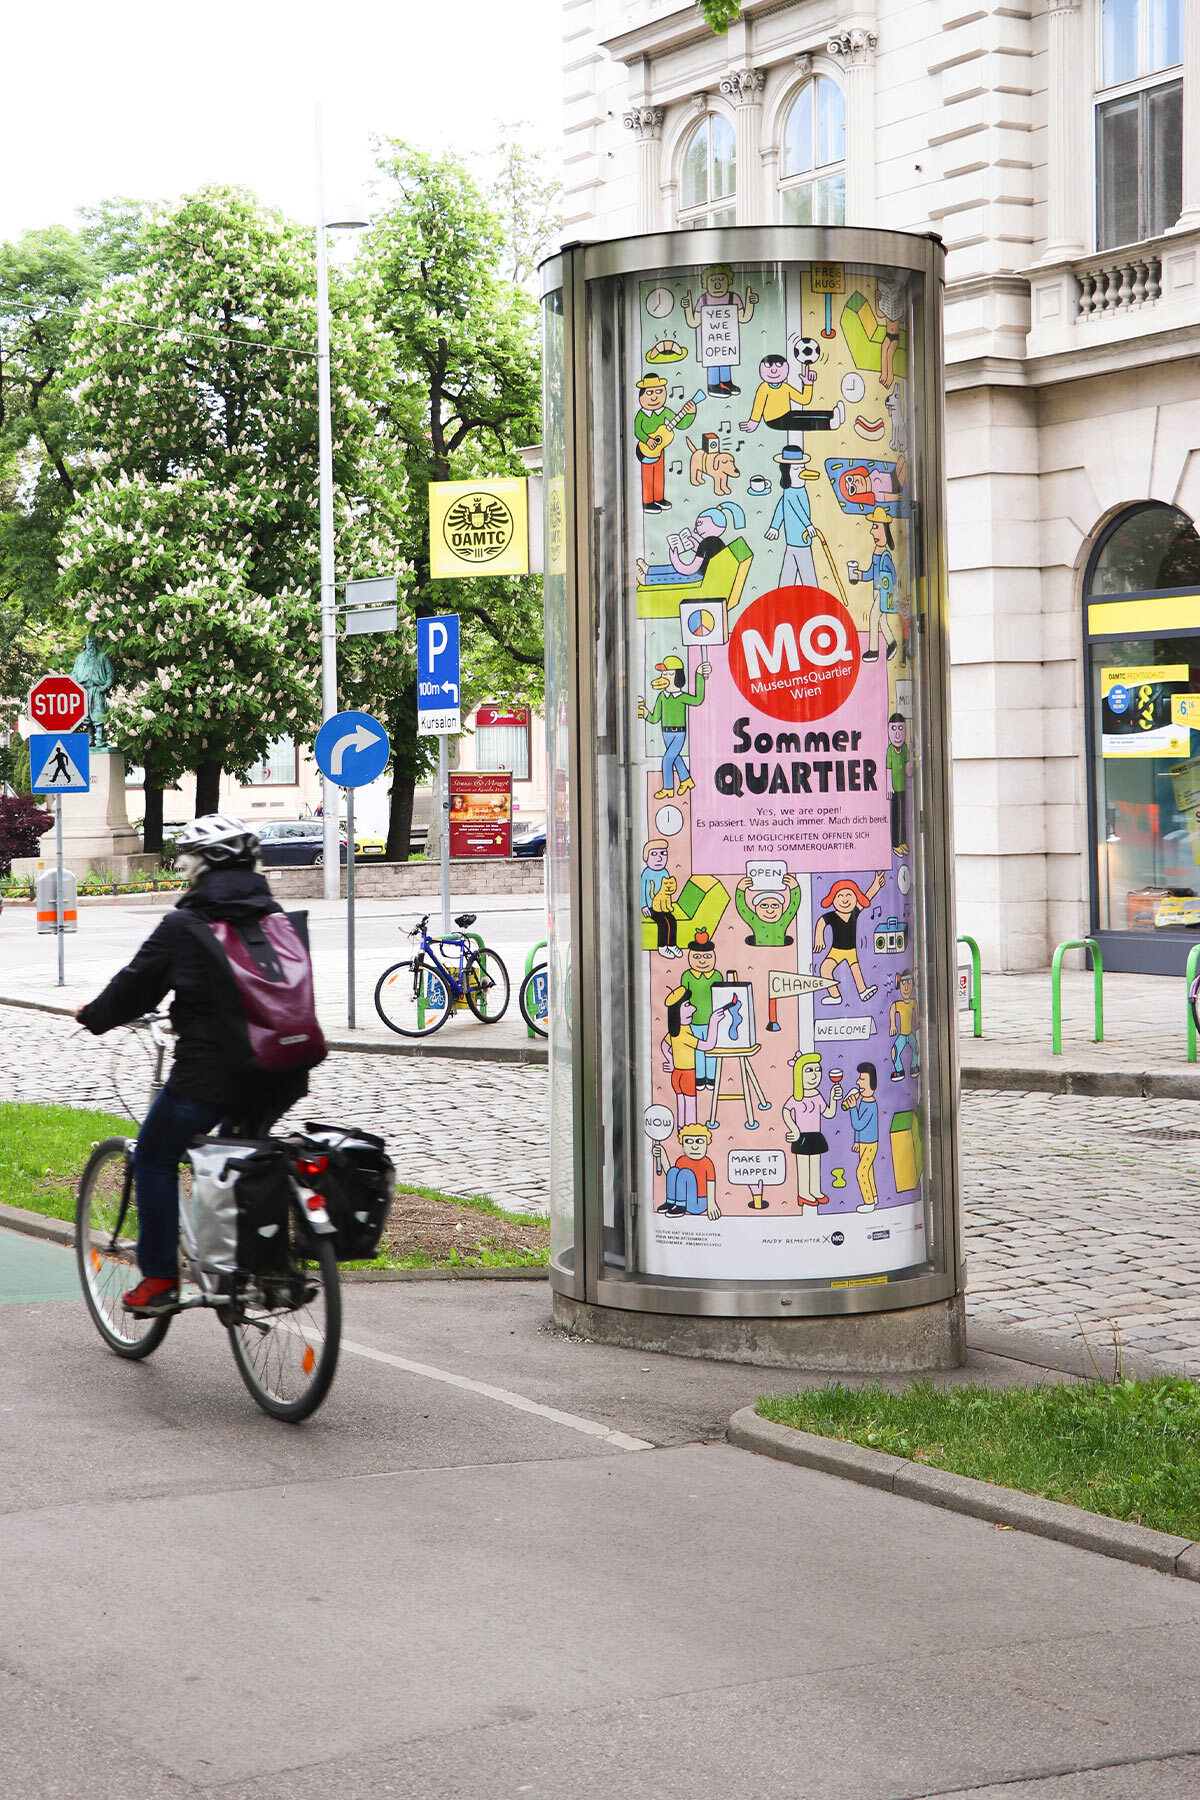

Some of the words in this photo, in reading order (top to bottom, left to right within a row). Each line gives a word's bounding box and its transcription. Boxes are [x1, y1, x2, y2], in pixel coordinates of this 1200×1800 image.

[815, 266, 841, 278] FREE
[814, 279, 841, 289] HUGS
[706, 309, 731, 319] YES
[710, 321, 728, 330] WE
[708, 332, 731, 342] ARE
[705, 346, 737, 357] OPEN
[428, 622, 448, 673] P
[741, 614, 853, 680] MQ
[750, 666, 852, 694] MuseumsQuartier
[419, 681, 440, 696] 100m
[790, 687, 822, 700] Wien
[35, 693, 81, 715] STOP
[421, 715, 457, 729] Kursalon
[733, 717, 861, 754] Sommer
[714, 759, 877, 798] QUARTIER
[756, 807, 776, 817] Yes,
[780, 808, 795, 816] we
[816, 806, 842, 816] open!
[696, 819, 706, 828] Es
[708, 819, 746, 829] passiert.
[749, 818, 770, 827] Was
[772, 817, 794, 826] auch
[796, 817, 826, 826] immer.
[828, 816, 850, 825] Mach
[852, 815, 868, 824] dich
[869, 815, 888, 824] bereit.
[723, 834, 744, 842] ALLE
[854, 831, 870, 839] SICH
[758, 844, 774, 852] MQ
[777, 842, 856, 851] SOMMERQUARTIER.
[749, 868, 782, 877] OPEN
[536, 977, 545, 995] P
[771, 976, 824, 992] CHANGE
[817, 1025, 867, 1036] WELCOME
[645, 1118, 672, 1127] NOW
[731, 1155, 761, 1163] MAKE
[734, 1168, 777, 1176] HAPPEN
